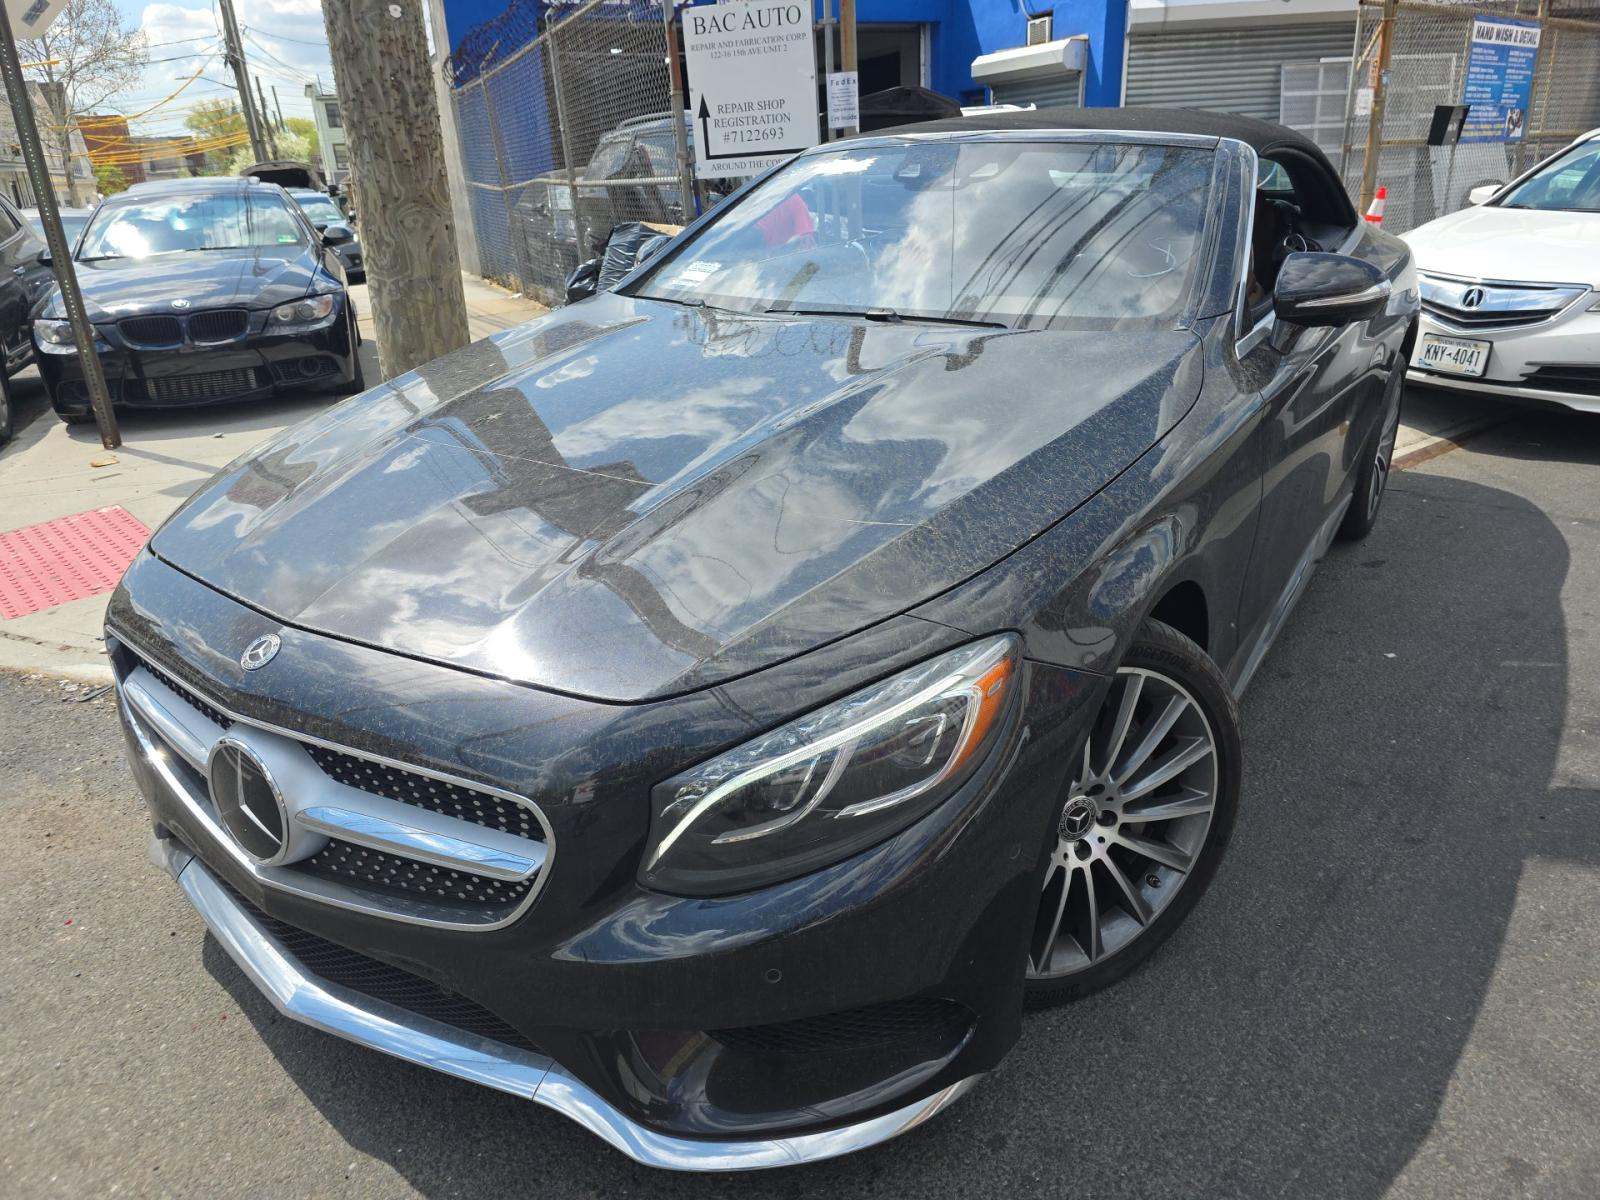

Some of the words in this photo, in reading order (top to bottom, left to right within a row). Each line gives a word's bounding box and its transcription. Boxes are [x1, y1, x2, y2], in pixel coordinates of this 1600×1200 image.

[693, 12, 737, 36] BAC
[742, 5, 802, 30] AUTO
[690, 41, 717, 52] REPAIR
[718, 39, 734, 49] AND
[735, 35, 784, 47] FABRICATION
[747, 47, 761, 56] AVE
[763, 45, 781, 54] UNIT
[783, 44, 788, 52] 2
[717, 101, 755, 114] REPAIR
[757, 98, 786, 111] SHOP
[713, 112, 792, 128] REGISTRATION
[722, 126, 784, 144] #7122693
[711, 161, 747, 171] AROUND
[749, 160, 763, 169] THE
